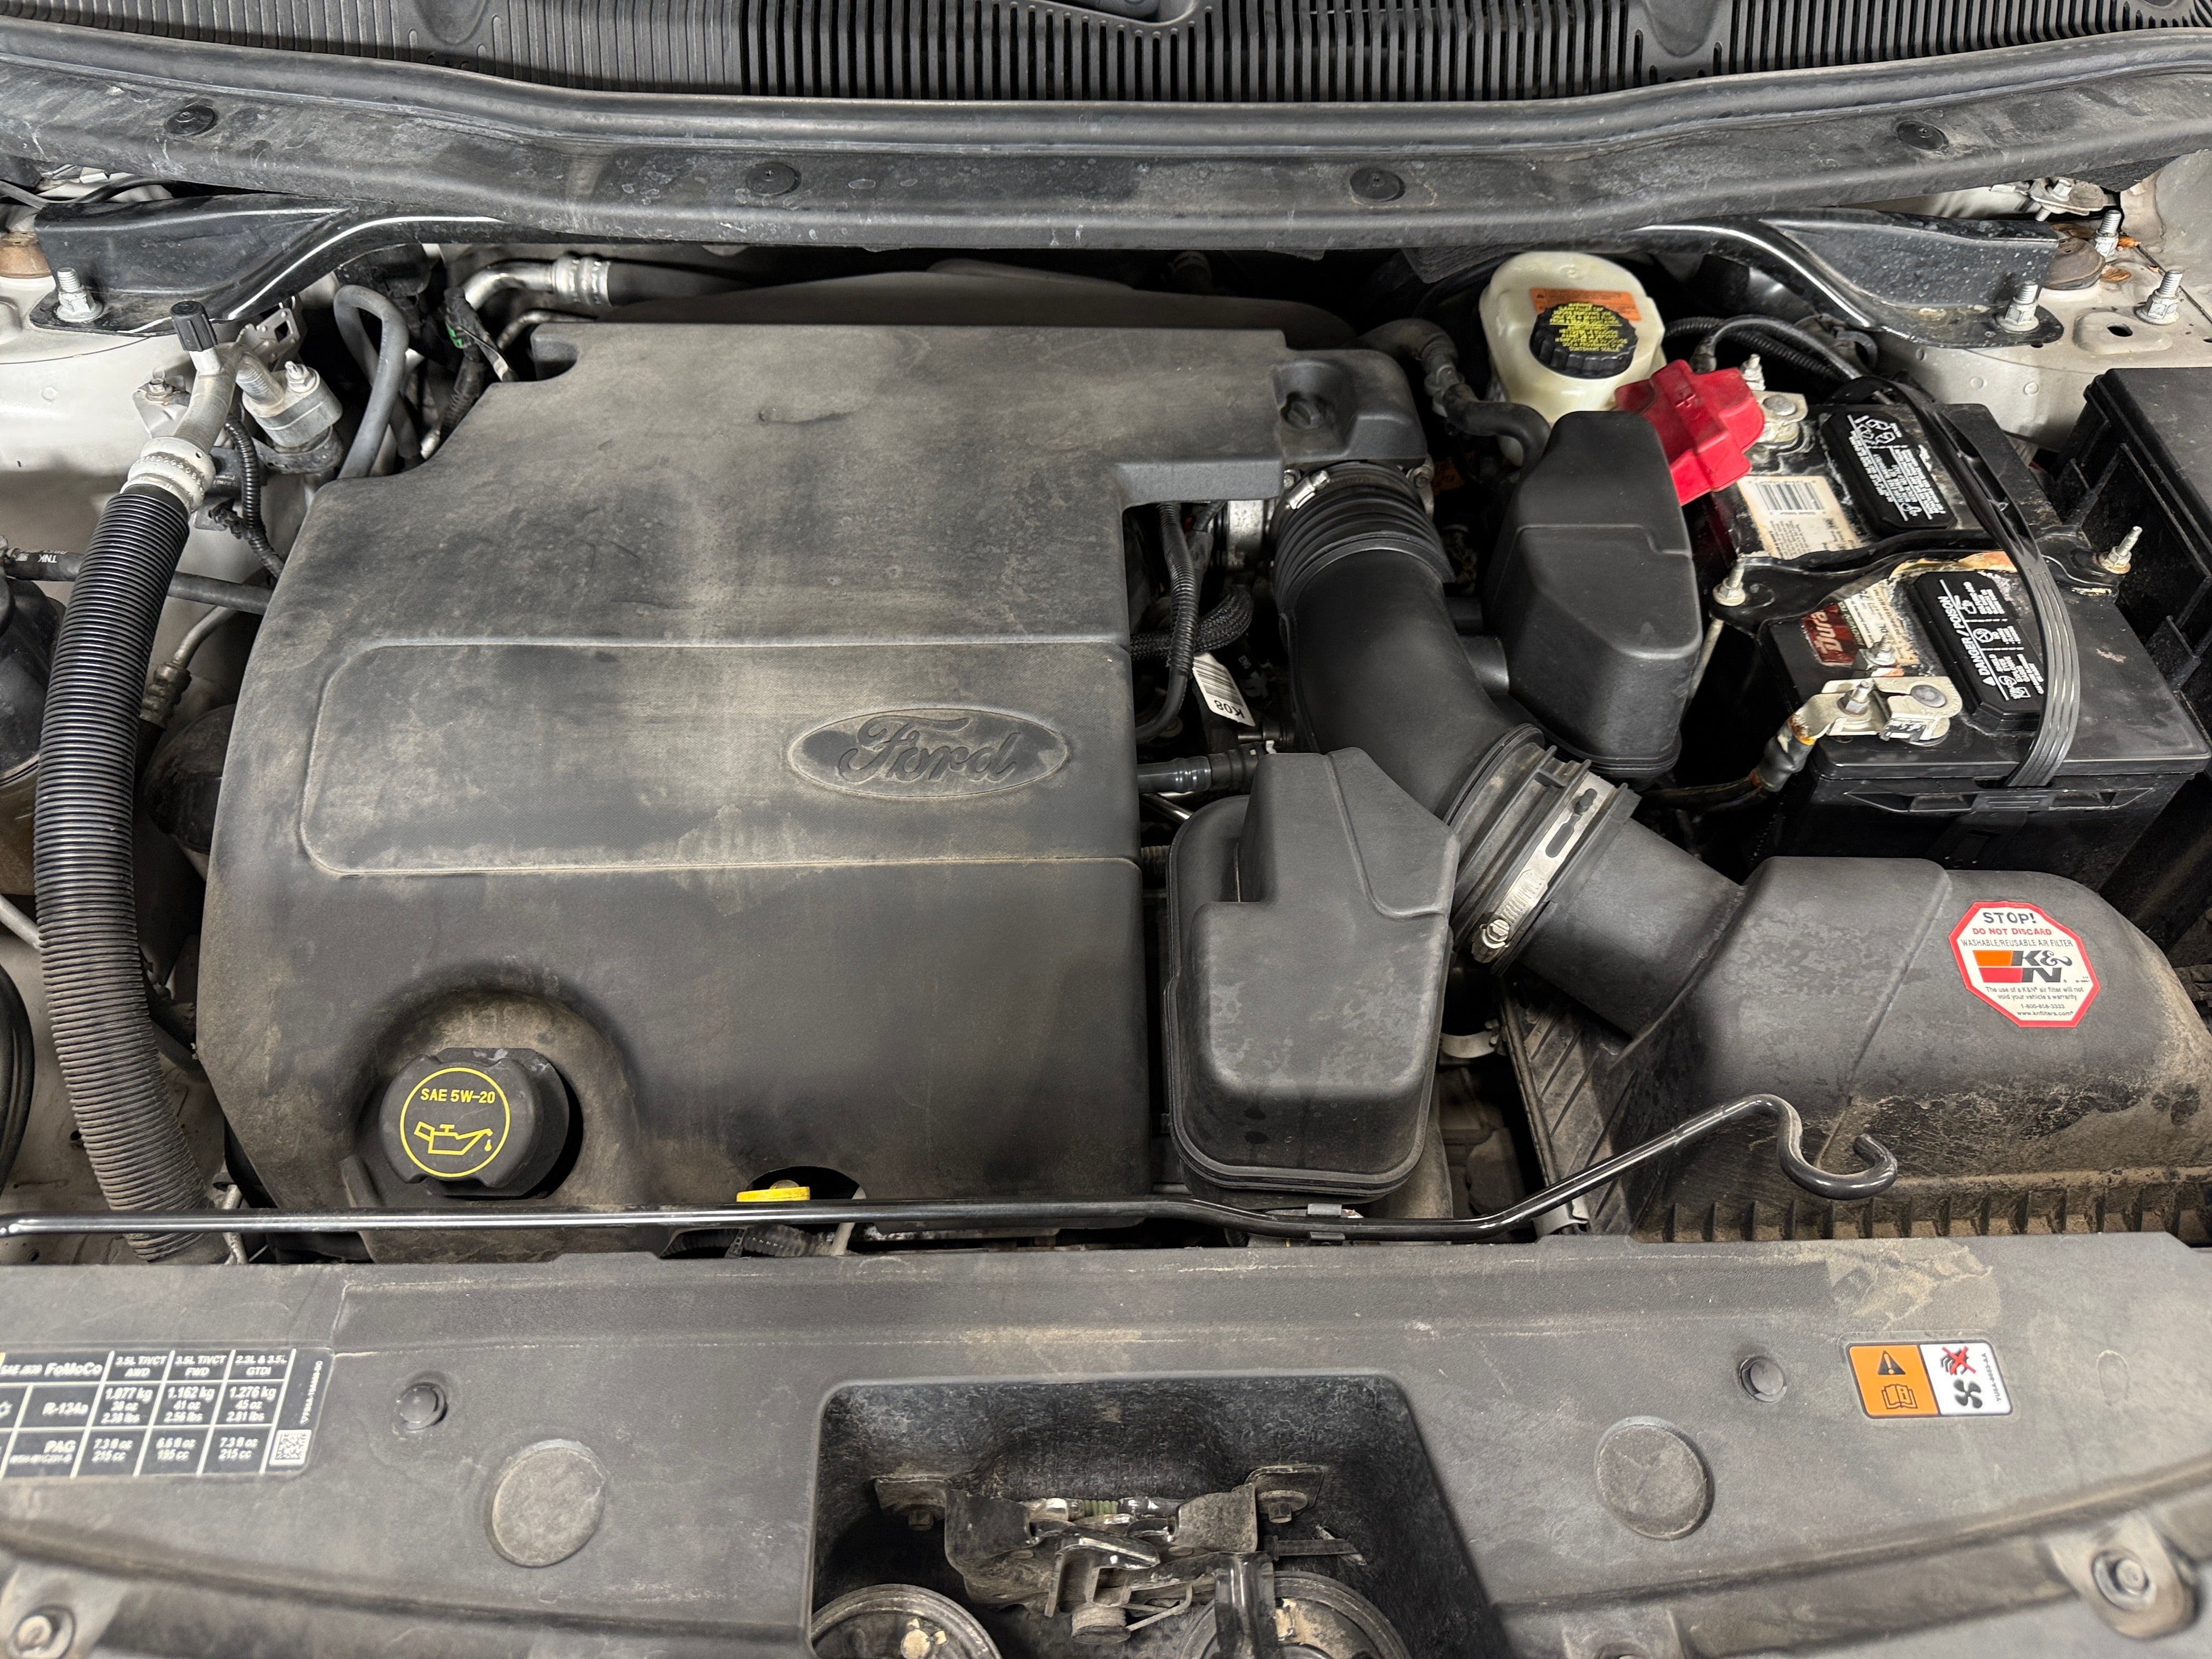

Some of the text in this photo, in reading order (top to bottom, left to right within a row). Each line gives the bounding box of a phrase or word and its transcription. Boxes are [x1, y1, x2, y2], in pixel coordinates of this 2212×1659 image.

[1938, 596, 1965, 629] POISON
[1961, 637, 1991, 675] DANGER
[1214, 700, 1245, 719] K08
[838, 714, 1022, 783] Ford
[1983, 911, 2037, 924] STOP!
[2012, 928, 2052, 936] DISCARD
[1960, 939, 2036, 947] WASHABLE/REUSABLE
[2050, 939, 2074, 947] FILTER
[420, 1088, 496, 1104] SAE 5W-20
[175, 1356, 195, 1365] 3.5L
[235, 1355, 287, 1364] 2.3L & 3.5L
[44, 1362, 103, 1376] FoMoCo
[125, 1367, 150, 1378] AWD
[185, 1367, 210, 1377] FWD
[137, 1387, 153, 1403] kg
[168, 1386, 215, 1402] 1.162 kg
[229, 1386, 276, 1402] 1.276 kg
[173, 1401, 200, 1410] 41 oz
[235, 1401, 262, 1410] 45 oz
[188, 1412, 203, 1423] lbs
[226, 1411, 264, 1422] 2.81 lbs
[43, 1440, 76, 1453] PAG
[120, 1440, 133, 1449] oz
[183, 1439, 195, 1449] oz
[220, 1437, 238, 1448] 7.3
[246, 1438, 259, 1448] oz
[92, 1451, 126, 1462] 215 cc
[176, 1451, 189, 1460] cc
[219, 1449, 252, 1460] 215 cc
